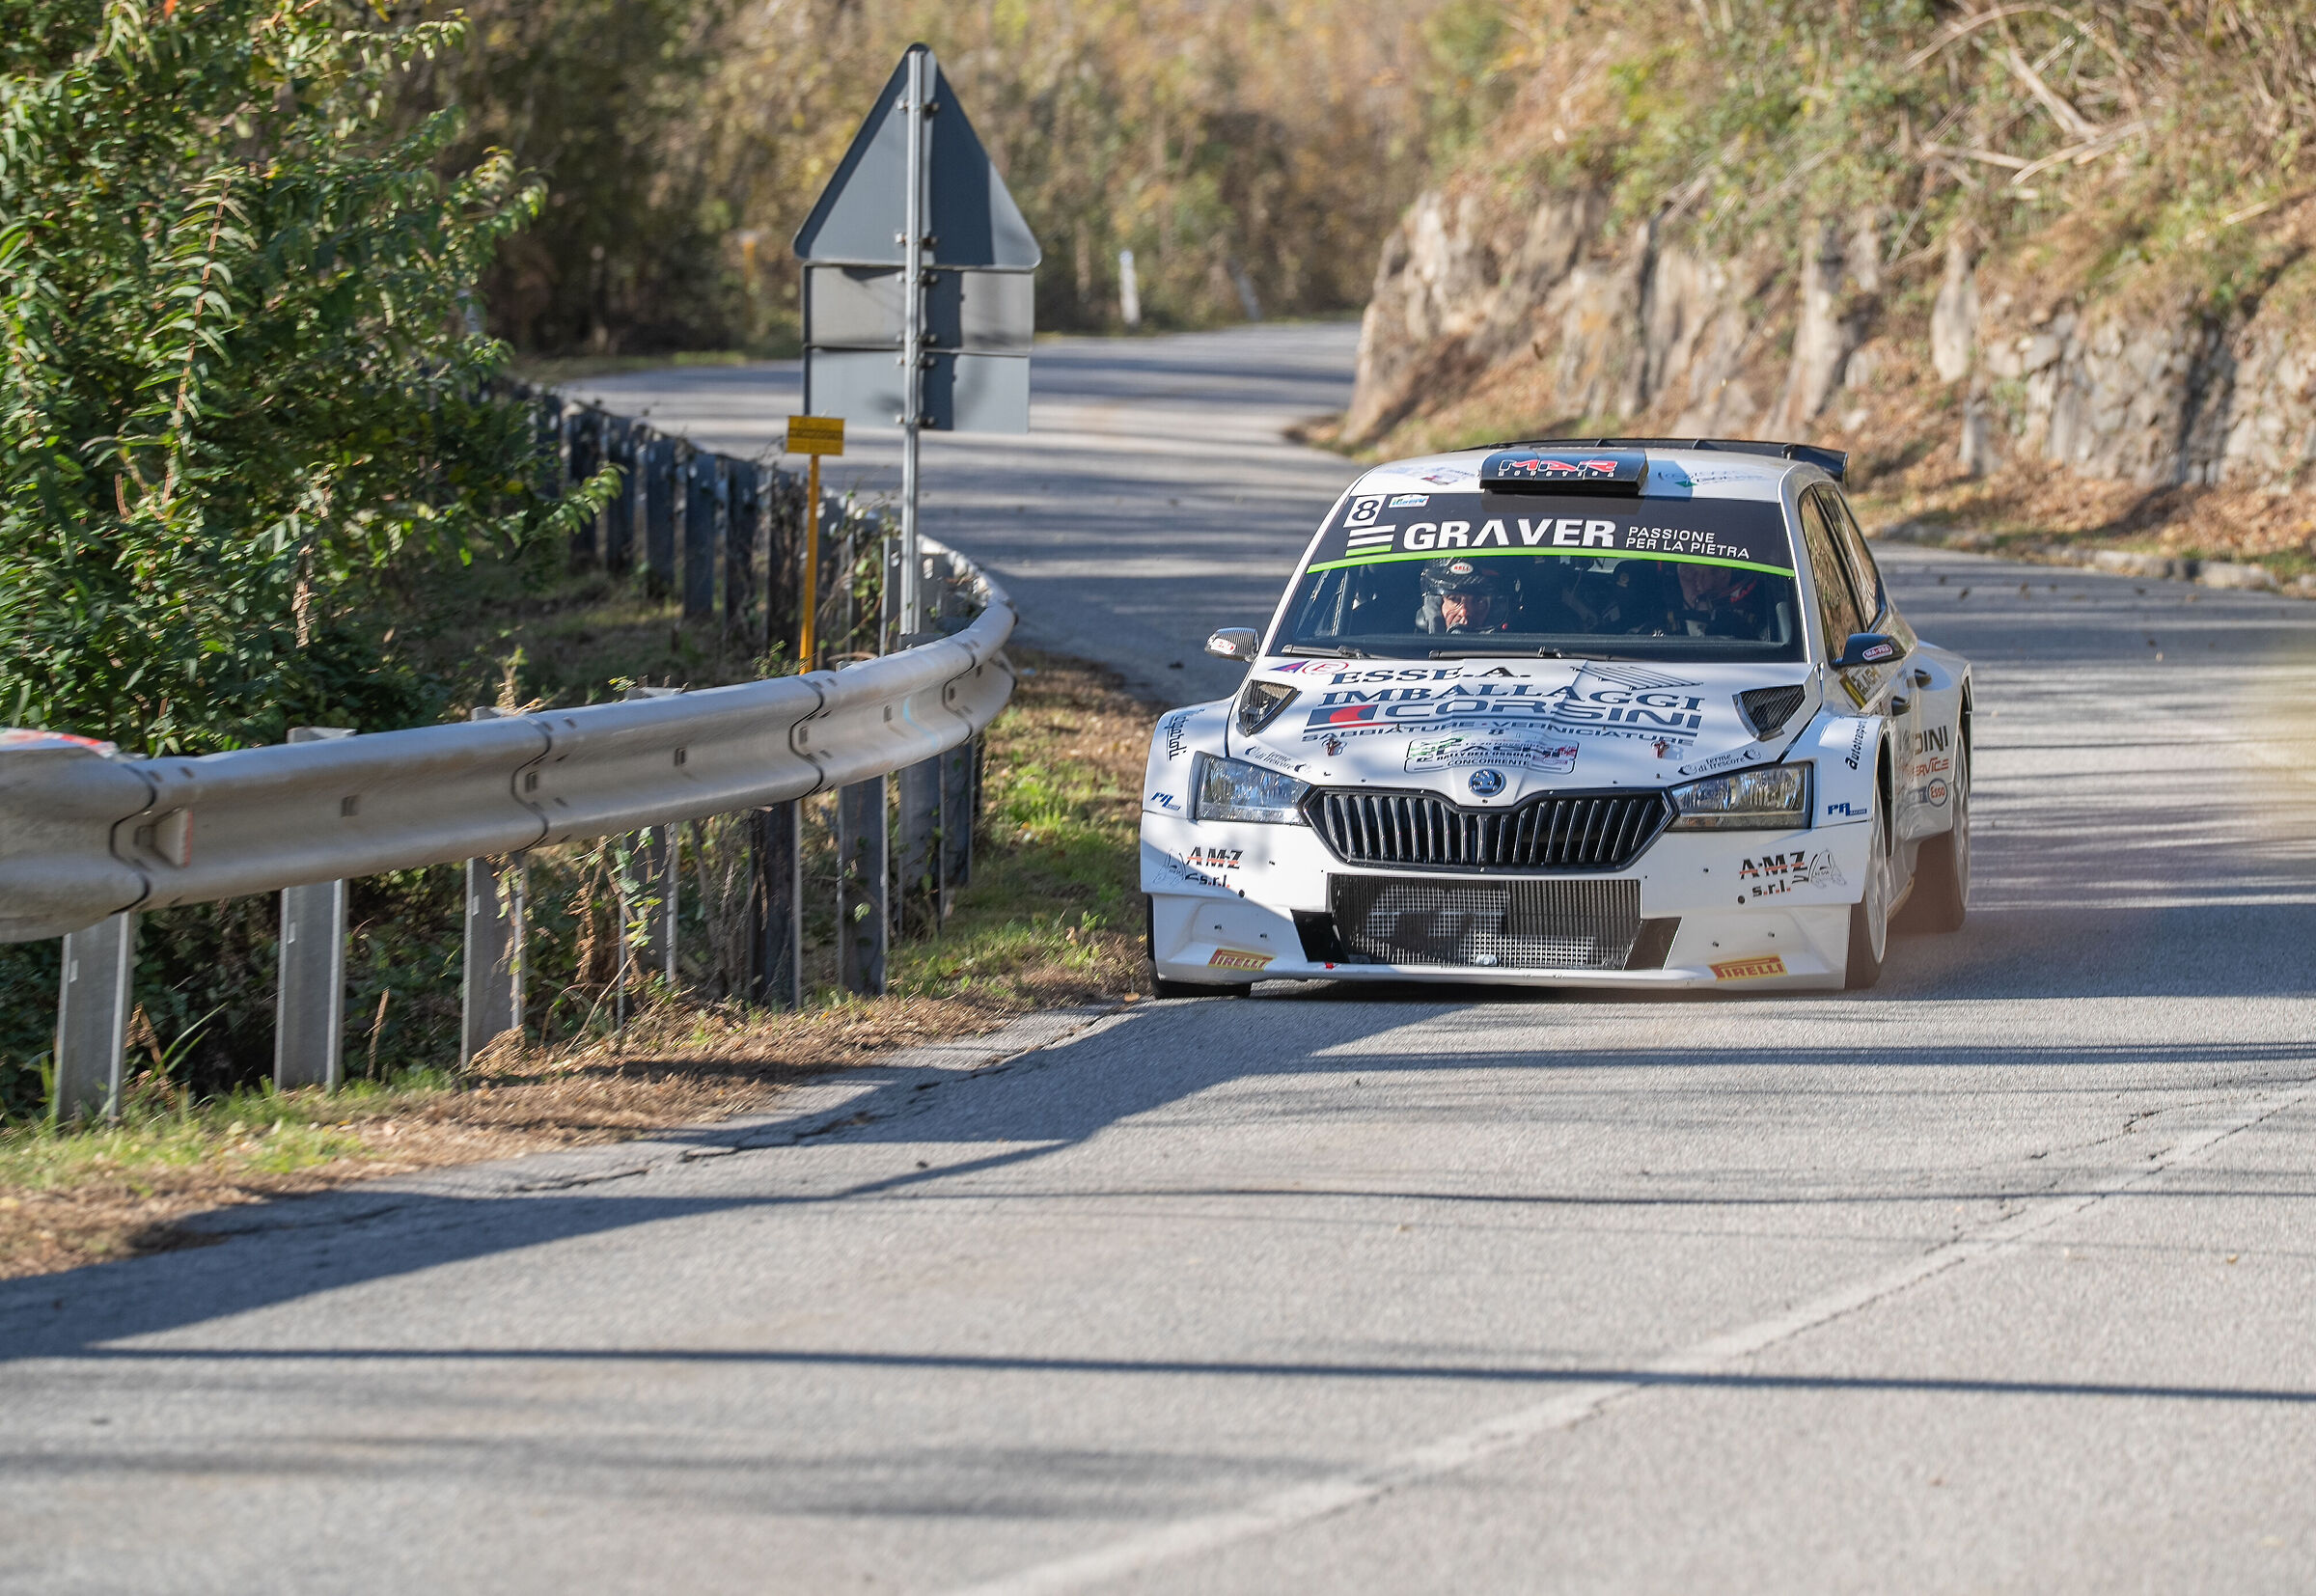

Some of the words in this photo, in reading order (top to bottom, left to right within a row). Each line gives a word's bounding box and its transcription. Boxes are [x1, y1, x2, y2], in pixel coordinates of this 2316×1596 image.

[1352, 500, 1379, 521] 8
[1403, 518, 1616, 550] GRAVER
[1628, 526, 1715, 543] PASSIONE
[1625, 537, 1657, 550] PER
[1663, 540, 1684, 552] LA
[1690, 542, 1750, 560] PIETRA
[1318, 684, 1705, 711] IMBALLAGGI
[1385, 699, 1703, 729] CORSINI
[1208, 949, 1274, 969] PIRELLI
[1709, 956, 1784, 978] PIRELLI
